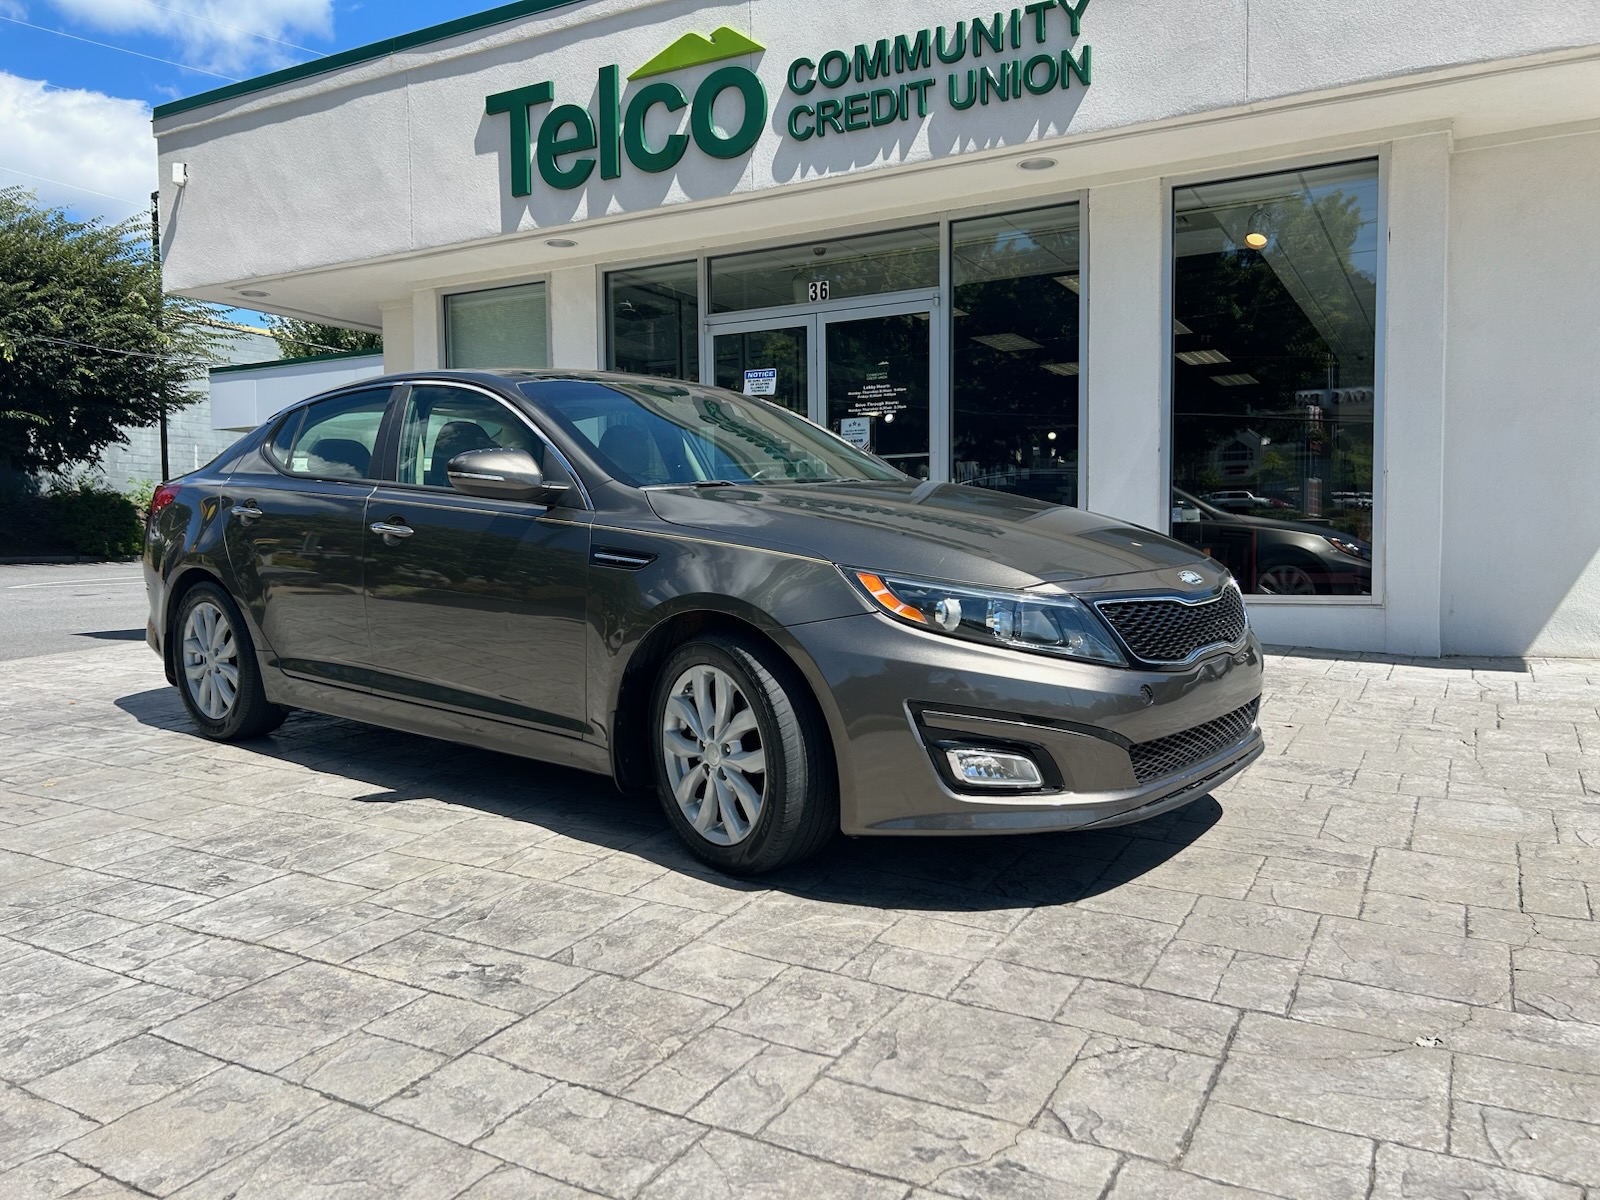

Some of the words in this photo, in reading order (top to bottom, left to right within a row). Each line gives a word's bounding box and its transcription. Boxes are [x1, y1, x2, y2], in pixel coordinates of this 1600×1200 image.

[787, 0, 1091, 96] COMMUNITY
[788, 78, 936, 141] CREDIT
[948, 45, 1091, 111] UNION
[485, 63, 768, 198] Telco
[810, 281, 828, 301] 36
[747, 371, 774, 379] NOTICE
